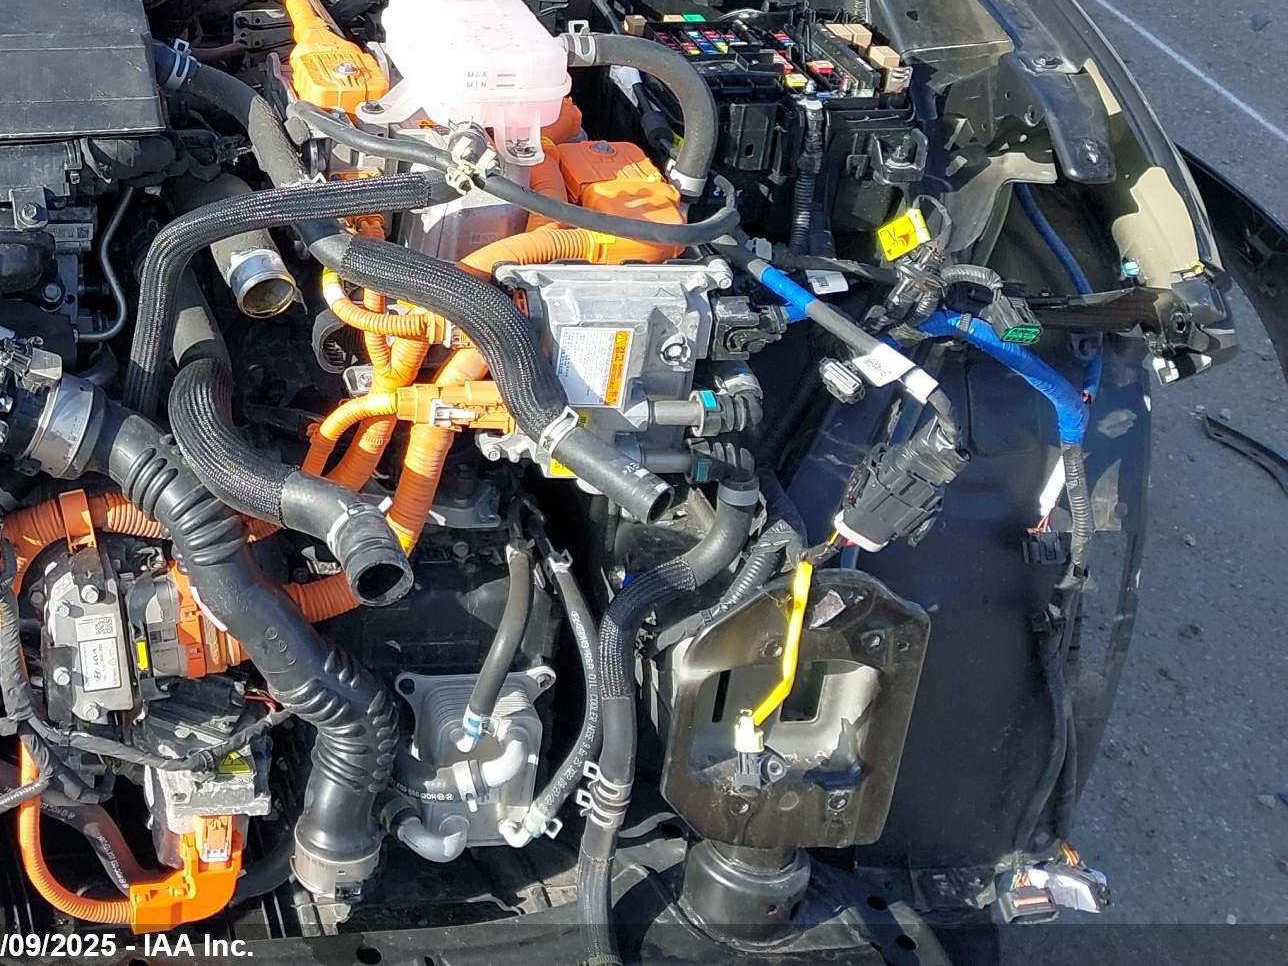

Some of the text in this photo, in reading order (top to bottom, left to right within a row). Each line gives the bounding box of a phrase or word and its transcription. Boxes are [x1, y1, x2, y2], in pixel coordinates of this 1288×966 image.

[466, 70, 488, 79] MAX
[466, 81, 487, 90] MIN
[588, 673, 597, 689] OIL
[588, 694, 599, 723] COOLER
